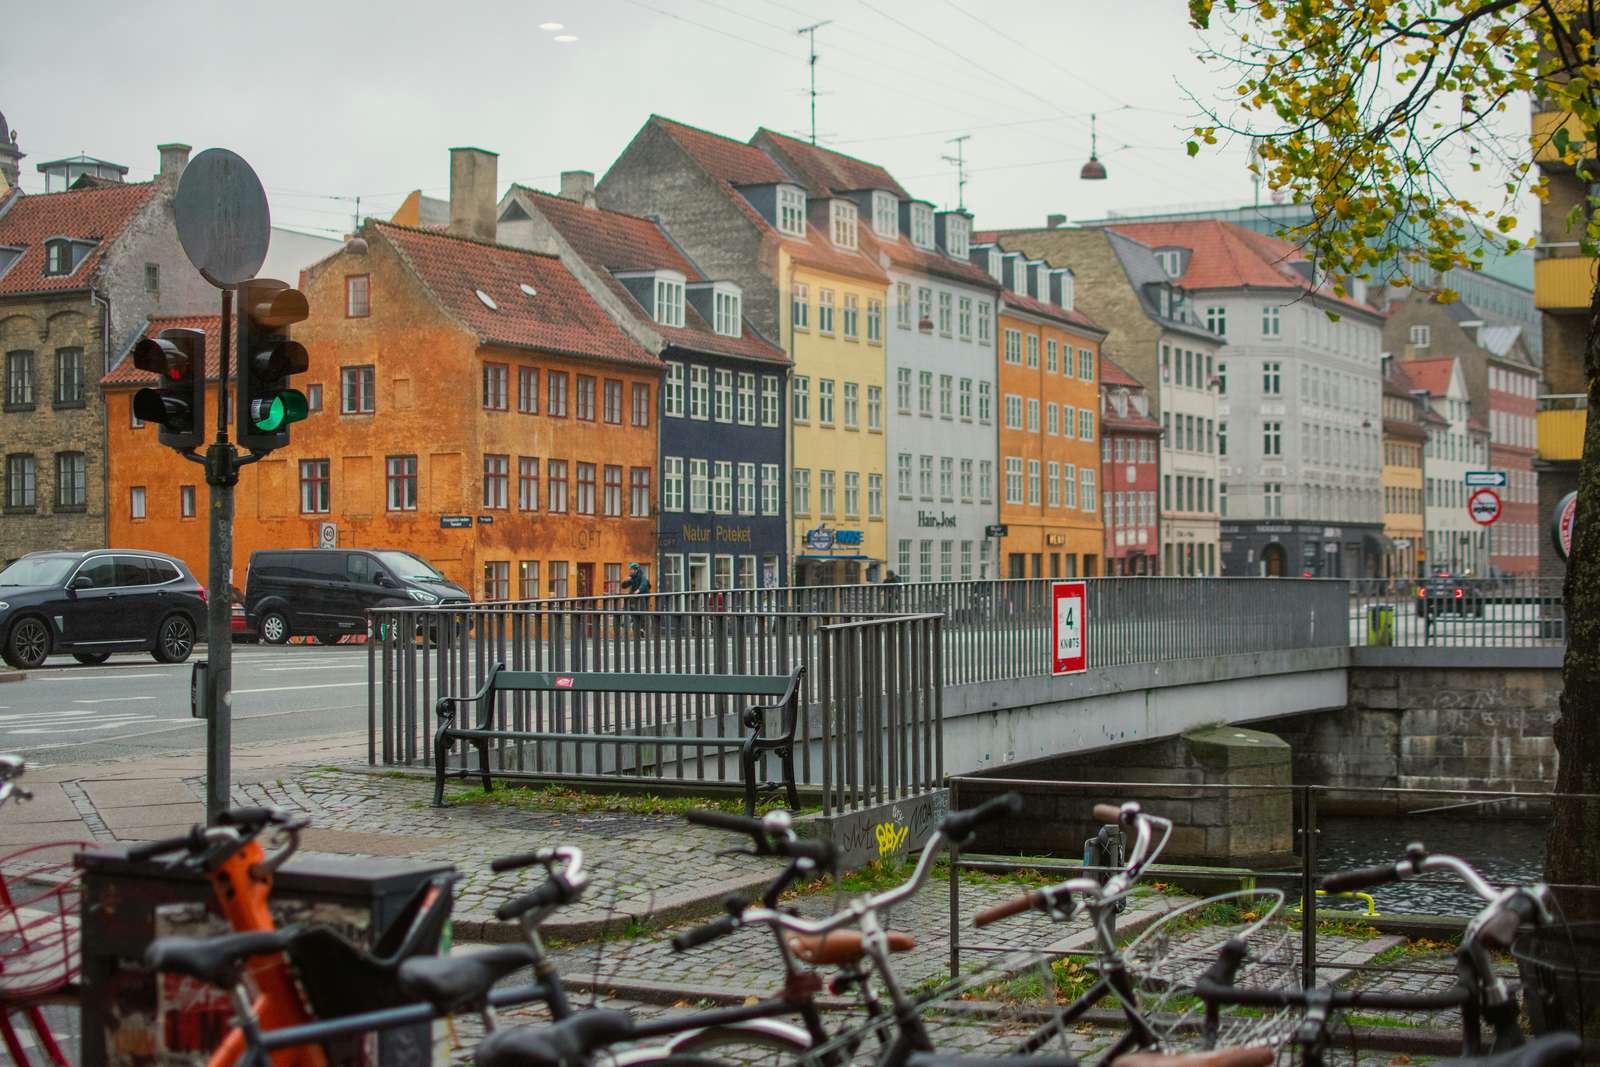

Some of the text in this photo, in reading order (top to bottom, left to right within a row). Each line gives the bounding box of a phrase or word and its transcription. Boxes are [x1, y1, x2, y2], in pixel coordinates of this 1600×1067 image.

[918, 510, 936, 527] Hair
[682, 523, 751, 542] Natur Poteket
[1066, 606, 1074, 630] 4
